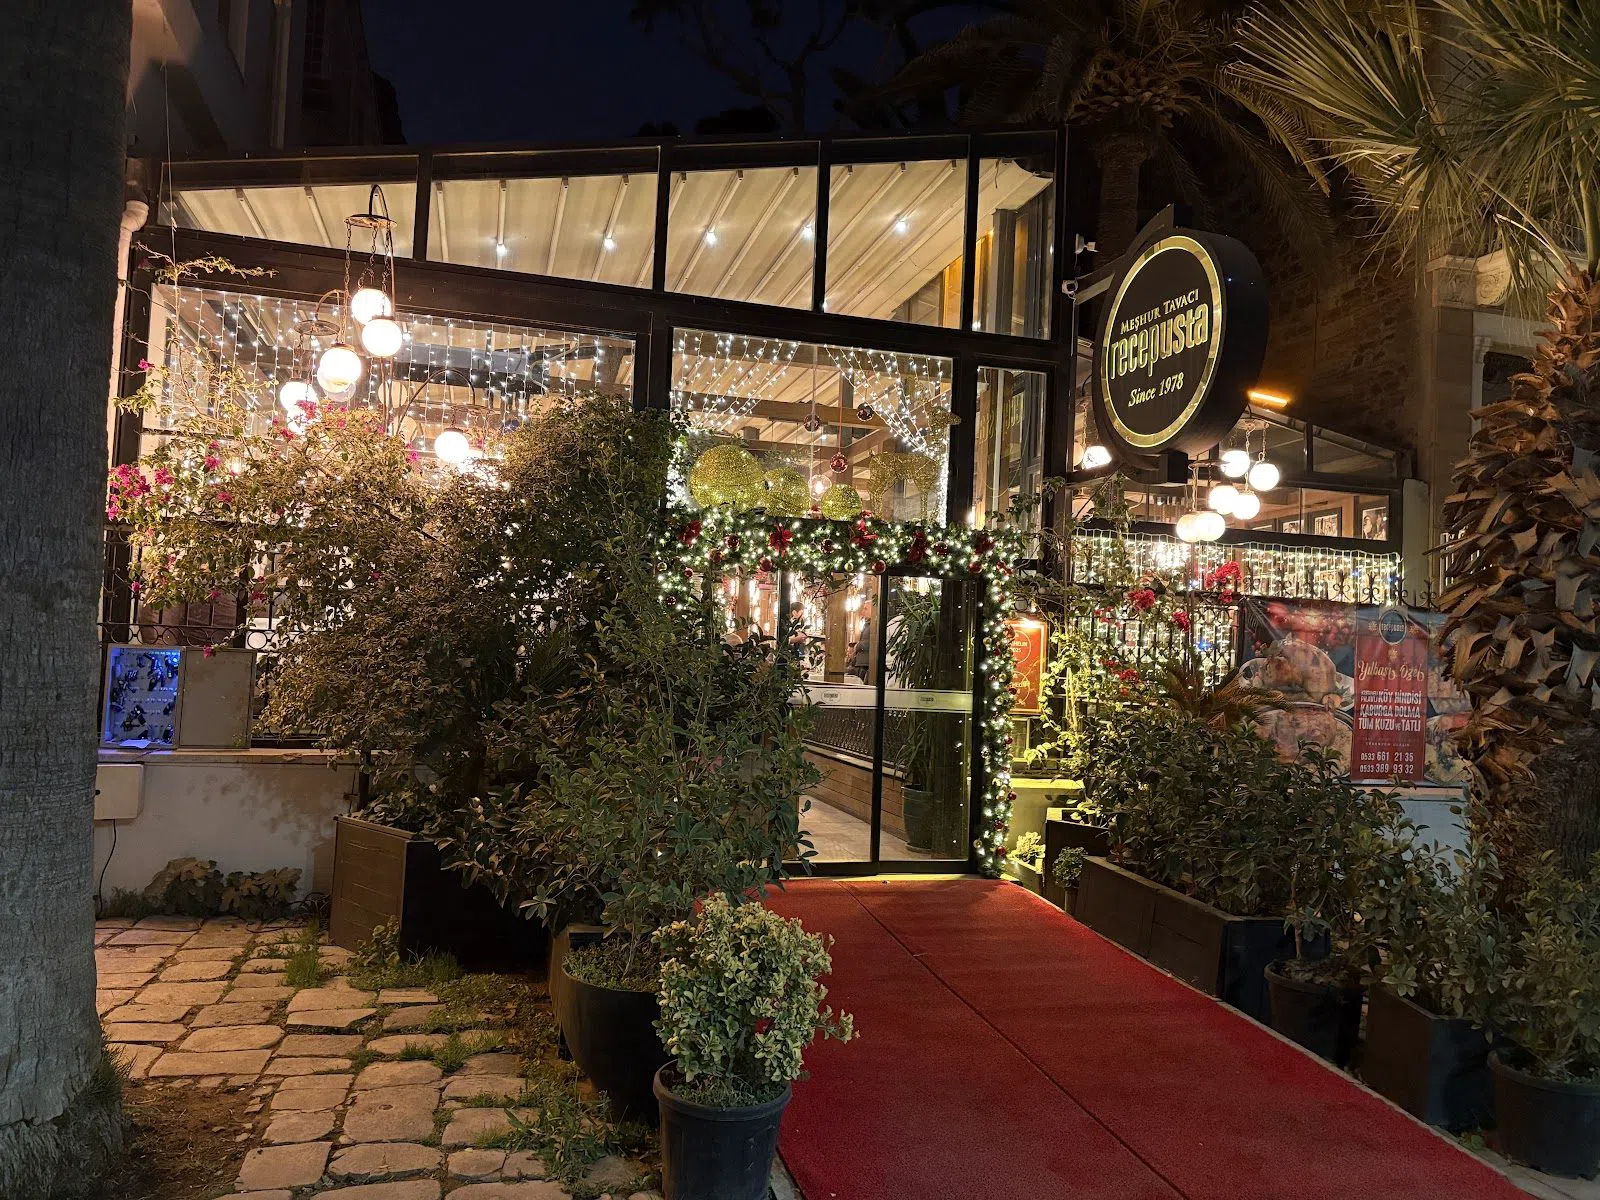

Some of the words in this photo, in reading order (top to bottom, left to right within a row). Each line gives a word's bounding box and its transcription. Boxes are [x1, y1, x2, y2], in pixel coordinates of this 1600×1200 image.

[1120, 306, 1161, 335] MEŞHUR
[1163, 288, 1199, 315] TAVACI
[1110, 302, 1209, 380] recepusta
[1128, 387, 1156, 408] Since
[1159, 372, 1185, 397] 1978
[1400, 661, 1425, 682] Özel
[1378, 688, 1393, 703] KÖY
[1360, 703, 1393, 717] KABURGA
[1394, 705, 1421, 719] DOLMA
[1358, 716, 1374, 730] TÜM
[1375, 718, 1394, 731] KUZU
[1401, 719, 1421, 732] TATLI
[1360, 752, 1375, 761] 0533
[1394, 752, 1402, 762] 21
[1404, 752, 1414, 762] 35
[1359, 764, 1374, 773] 0533
[1375, 763, 1389, 773] 389
[1393, 763, 1403, 774] 93
[1404, 764, 1414, 774] 32
